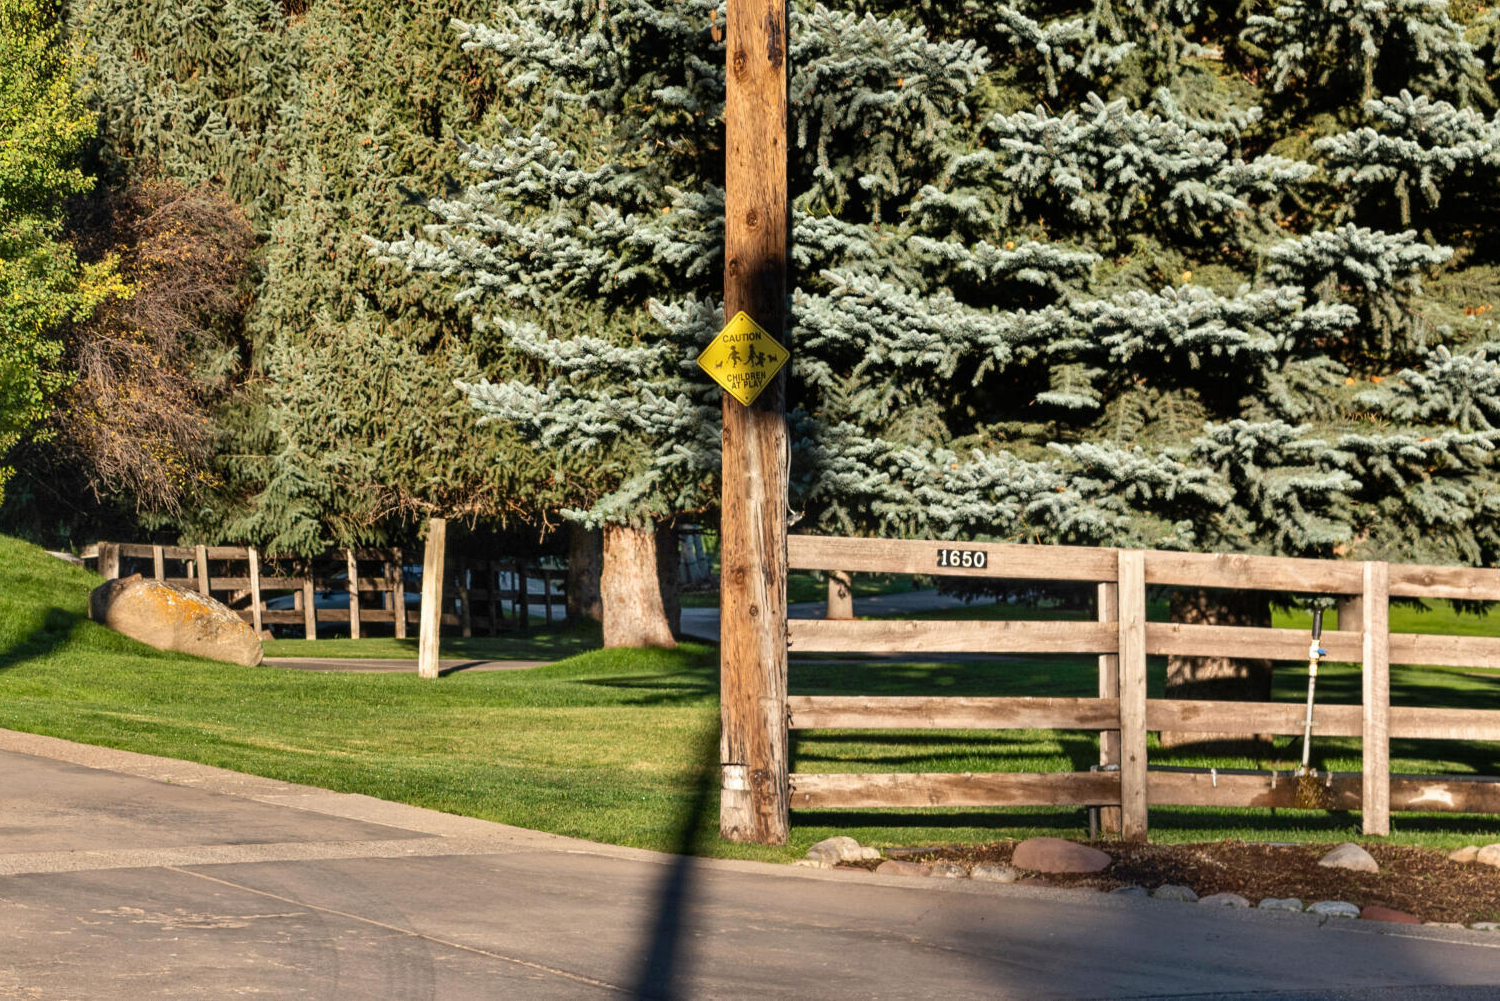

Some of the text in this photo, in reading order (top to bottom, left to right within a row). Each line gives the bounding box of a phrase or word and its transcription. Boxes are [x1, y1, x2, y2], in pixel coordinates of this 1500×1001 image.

[722, 332, 762, 343] CAUTION
[726, 371, 766, 382] CHILDREN
[731, 381, 763, 390] AT PLAY
[941, 549, 985, 568] 1650
